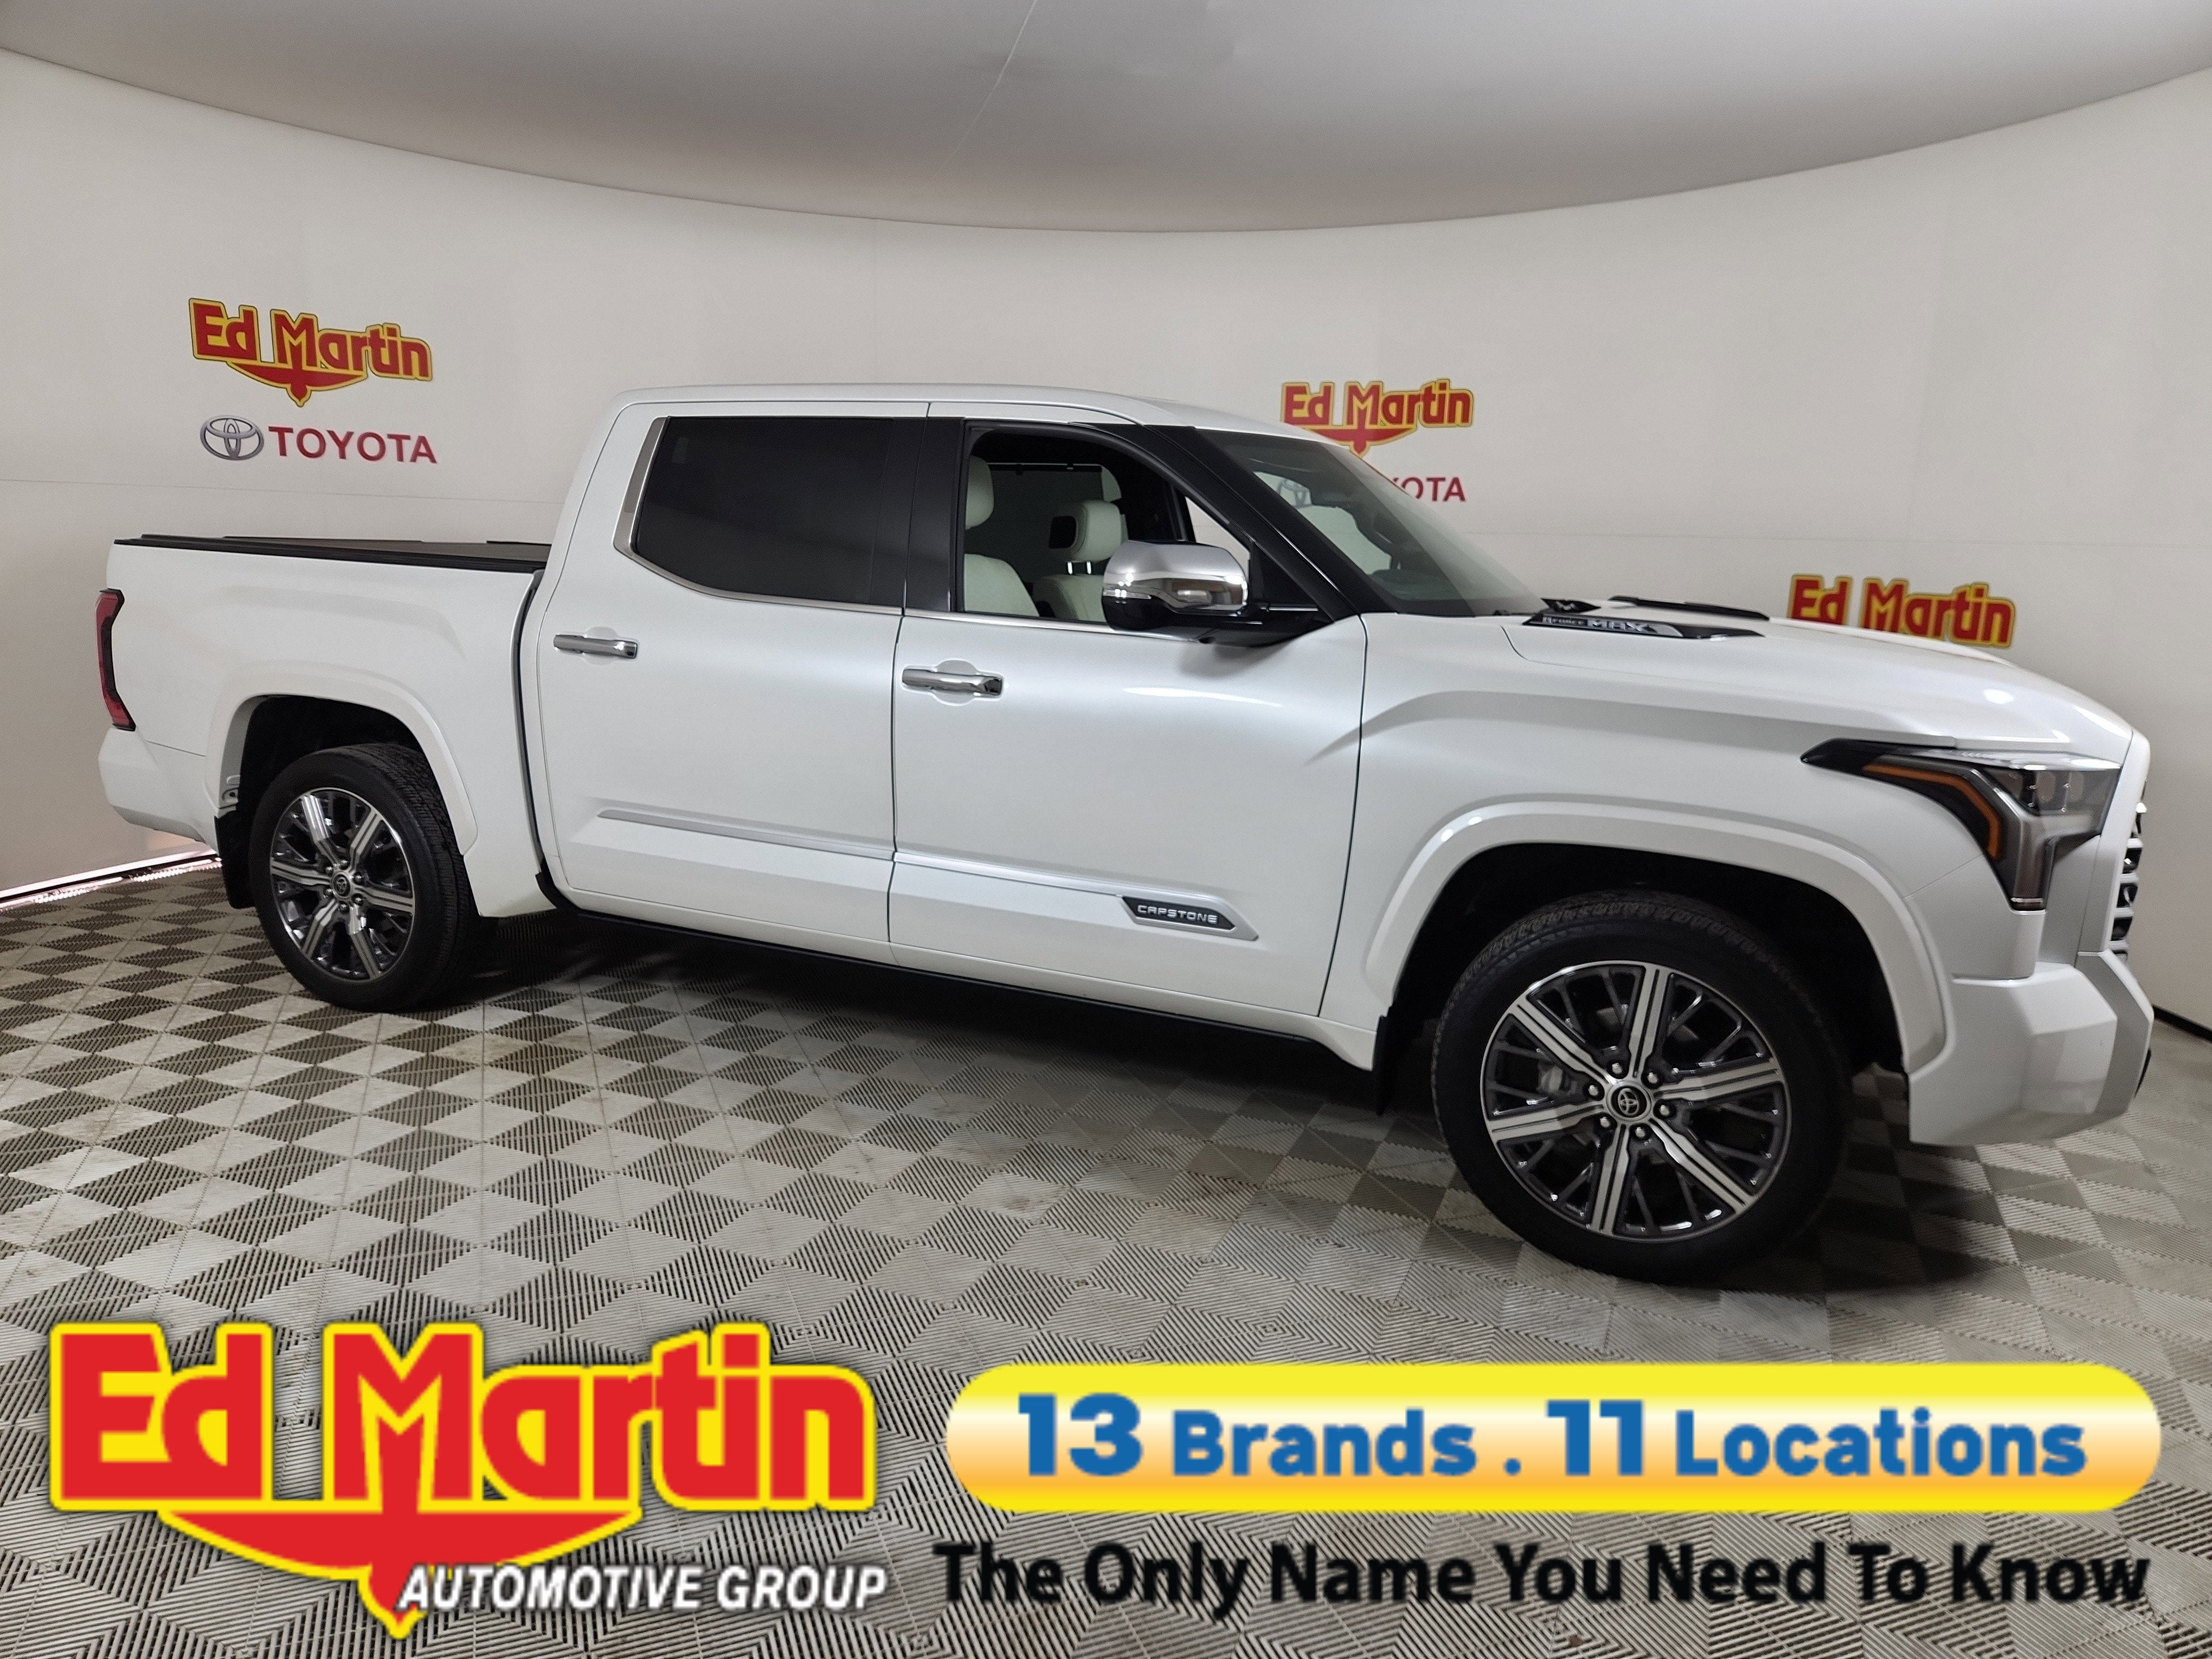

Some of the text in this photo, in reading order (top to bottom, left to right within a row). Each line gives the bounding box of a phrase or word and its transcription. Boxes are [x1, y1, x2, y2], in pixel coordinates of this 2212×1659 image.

[190, 300, 431, 380] Ed Martin
[1283, 381, 1473, 427] Ed Martin
[268, 425, 437, 464] TOYOTA
[1791, 577, 2014, 646] Ed Martin
[1137, 905, 1218, 924] CAPSTONE
